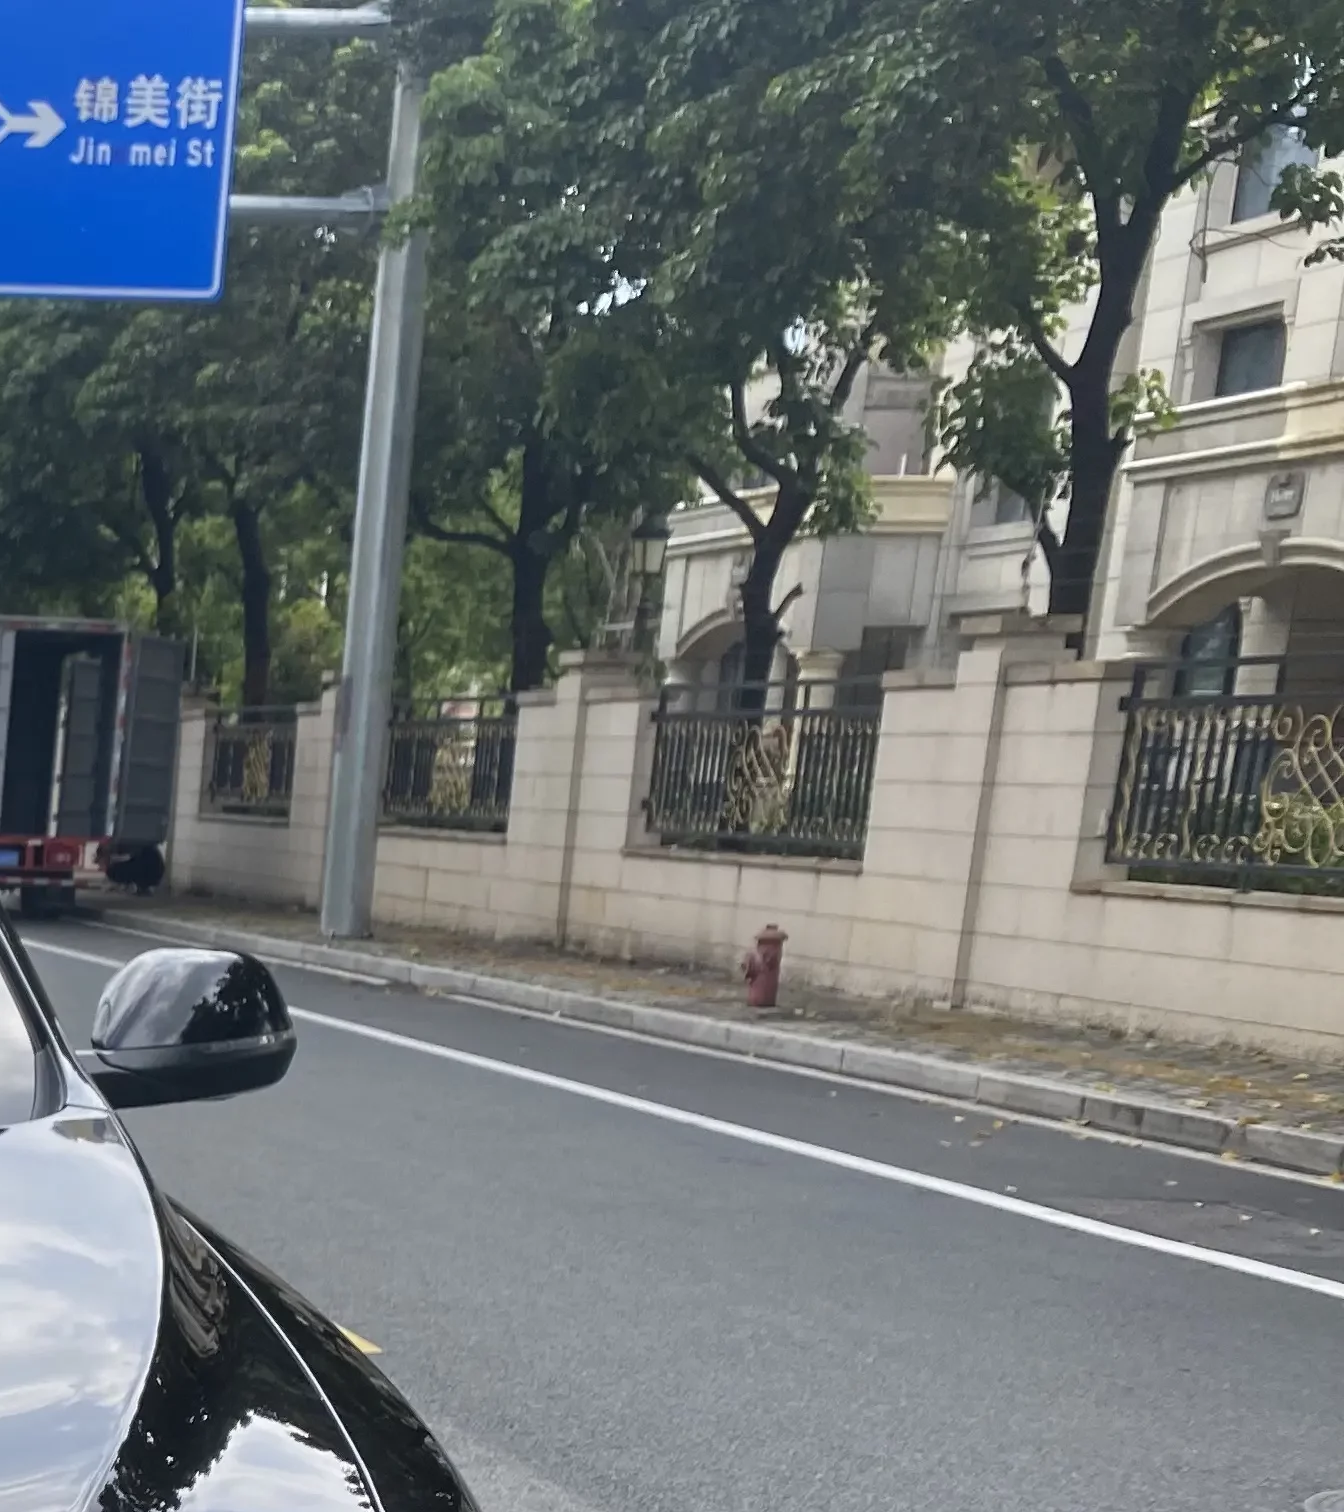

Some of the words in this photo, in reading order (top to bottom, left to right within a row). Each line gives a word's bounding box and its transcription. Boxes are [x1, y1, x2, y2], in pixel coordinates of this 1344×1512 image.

[75, 74, 223, 129] 锦美街
[69, 136, 112, 166] Jin
[129, 137, 177, 167] mei
[185, 137, 215, 168] St
